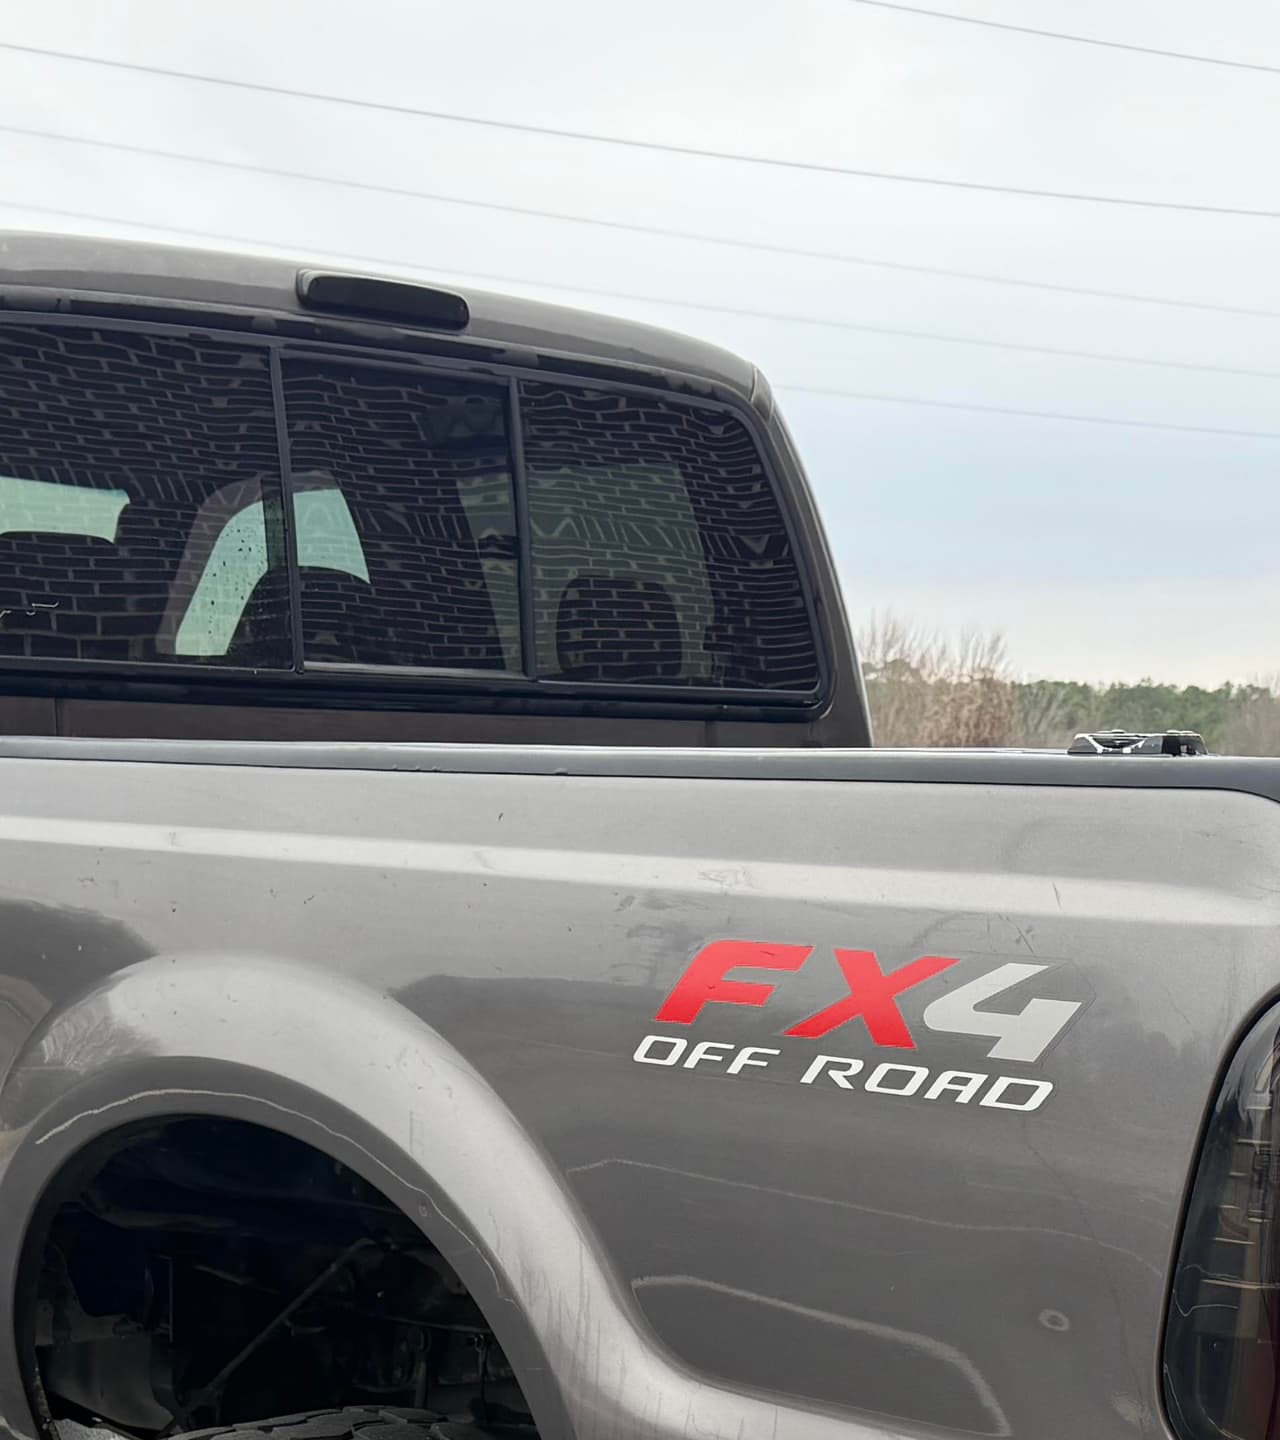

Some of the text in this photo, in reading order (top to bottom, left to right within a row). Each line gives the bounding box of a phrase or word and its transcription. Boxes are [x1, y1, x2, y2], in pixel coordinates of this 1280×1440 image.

[653, 939, 1083, 1063] FX4
[632, 1035, 1054, 1112] OFF ROAD
